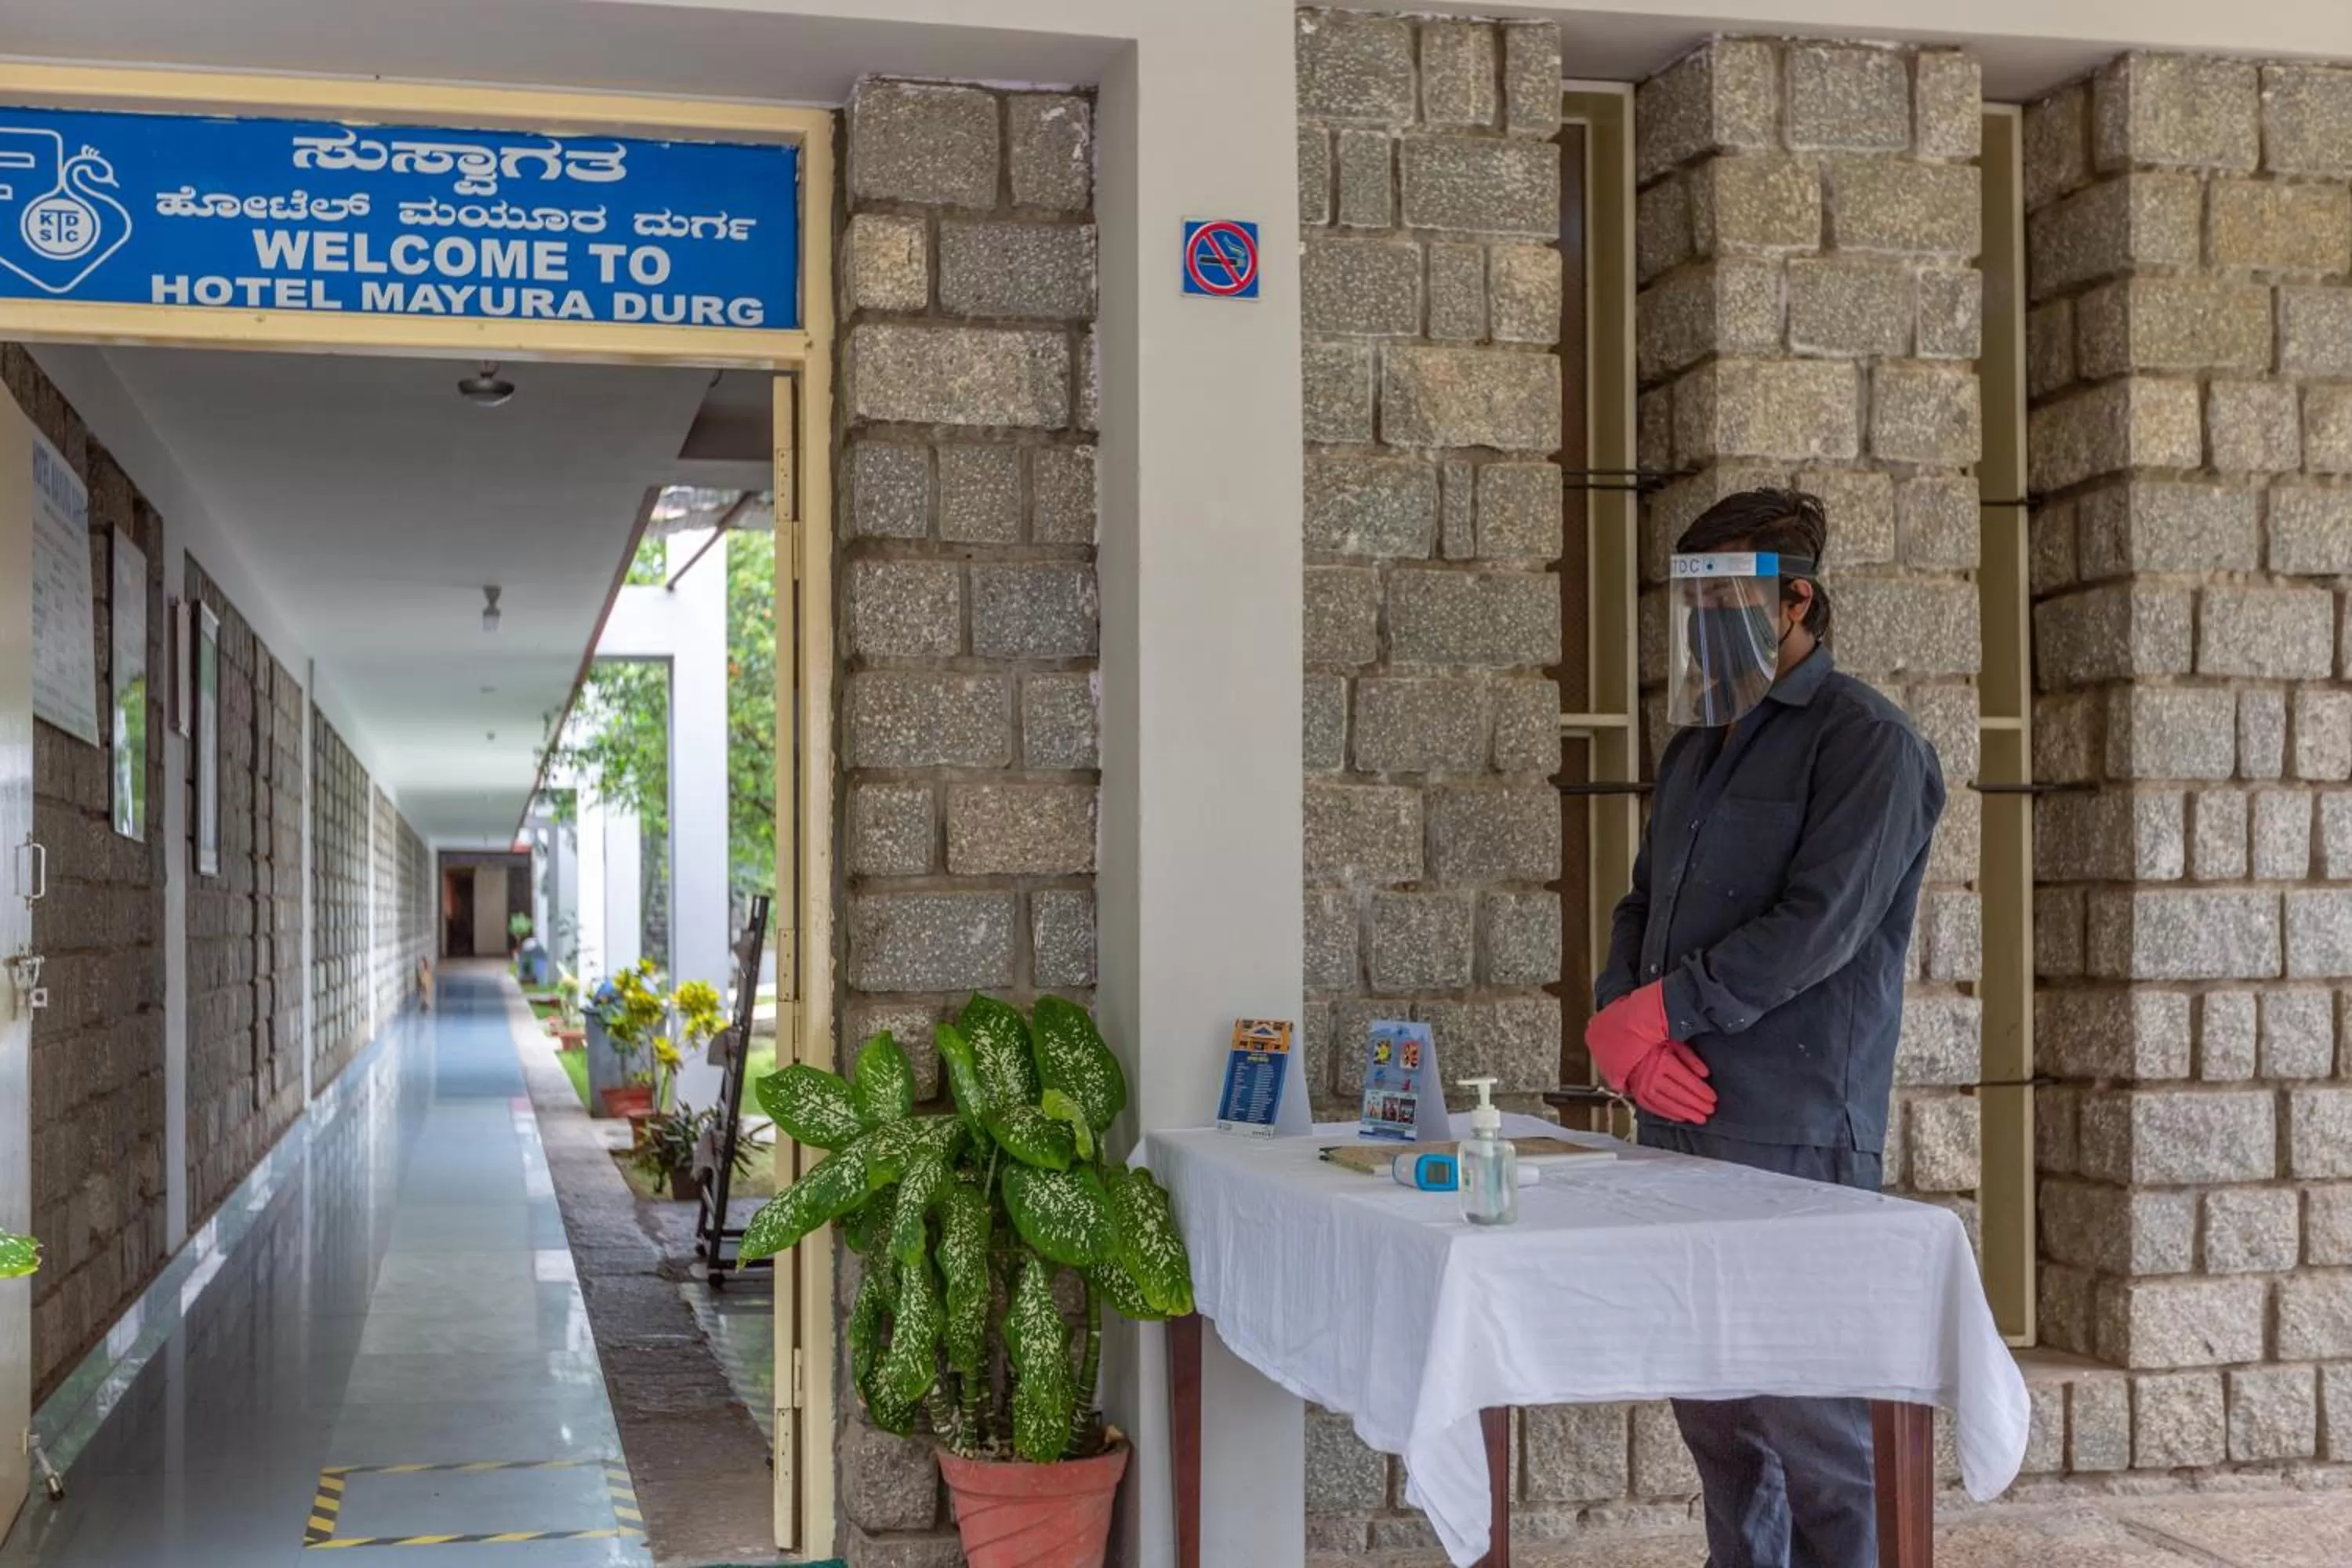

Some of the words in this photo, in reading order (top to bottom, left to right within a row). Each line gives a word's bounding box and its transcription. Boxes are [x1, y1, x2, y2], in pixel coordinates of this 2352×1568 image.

[292, 129, 627, 196] ಸುಸ್ವಾಗತ
[156, 186, 369, 221] ಹೋಟೆಲ್
[399, 197, 607, 233] ಮಯೂರ
[633, 207, 757, 241] ದುರ್ಗ
[252, 228, 569, 282] WELCOME
[589, 242, 671, 286] TO
[151, 274, 343, 310] HOTEL
[361, 281, 595, 320] MAYURA
[613, 291, 764, 326] DURG
